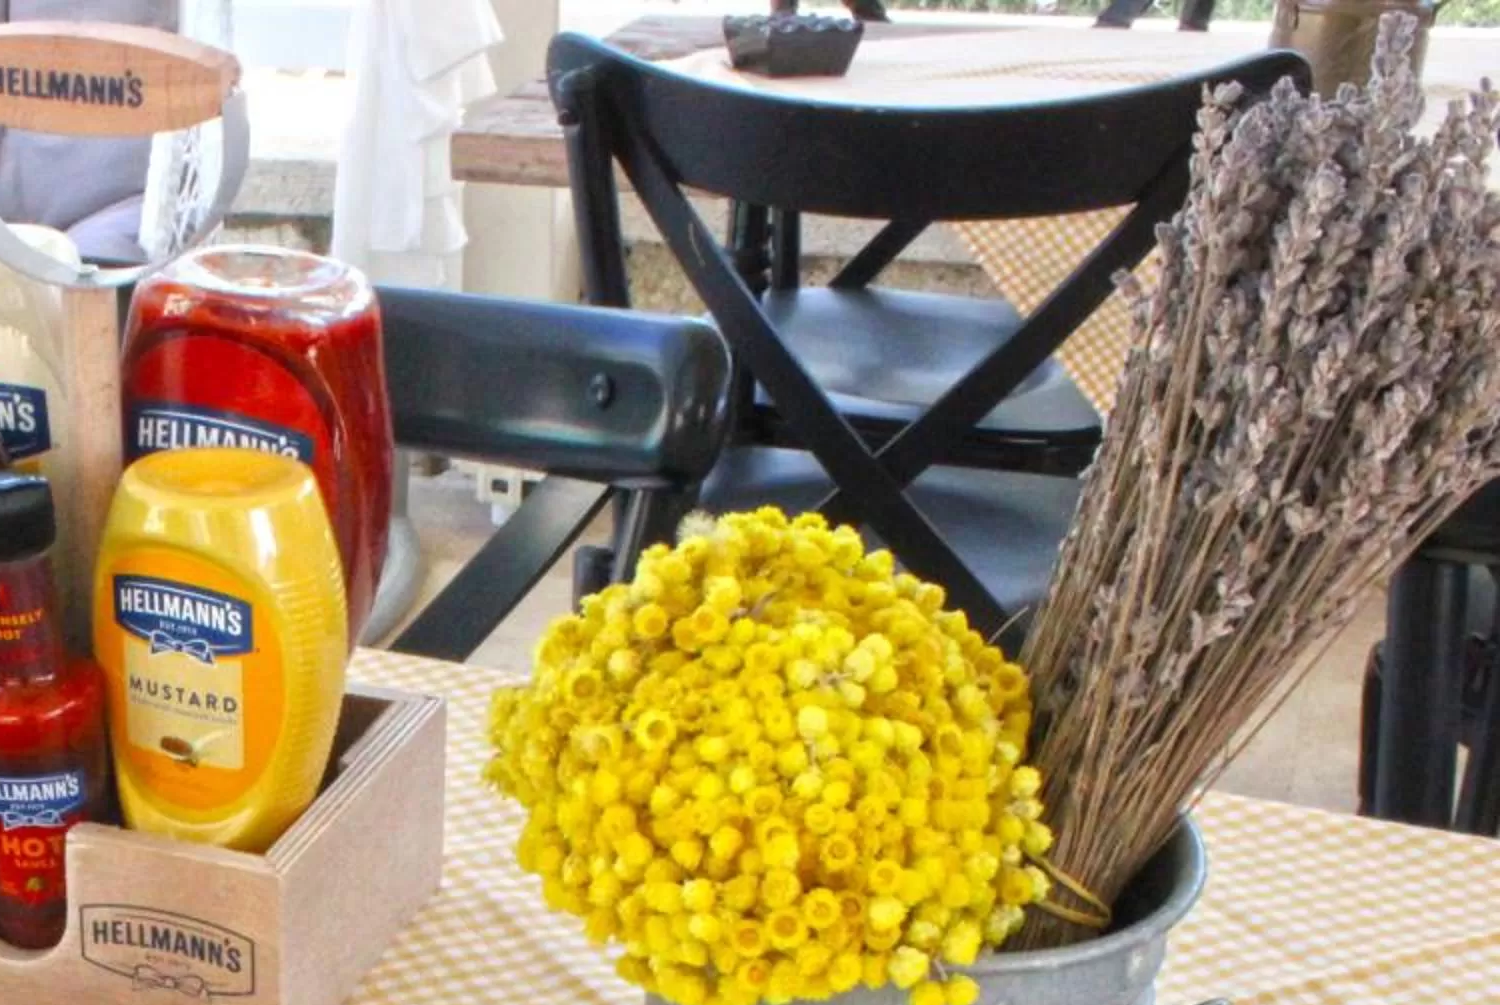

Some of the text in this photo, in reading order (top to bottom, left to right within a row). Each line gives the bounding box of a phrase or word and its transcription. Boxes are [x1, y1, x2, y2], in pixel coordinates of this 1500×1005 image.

[120, 587, 243, 636] HELLMANN'S
[129, 674, 237, 713] MUSTARD
[1, 834, 63, 857] HOT
[92, 919, 242, 974] HELLMANN'S
